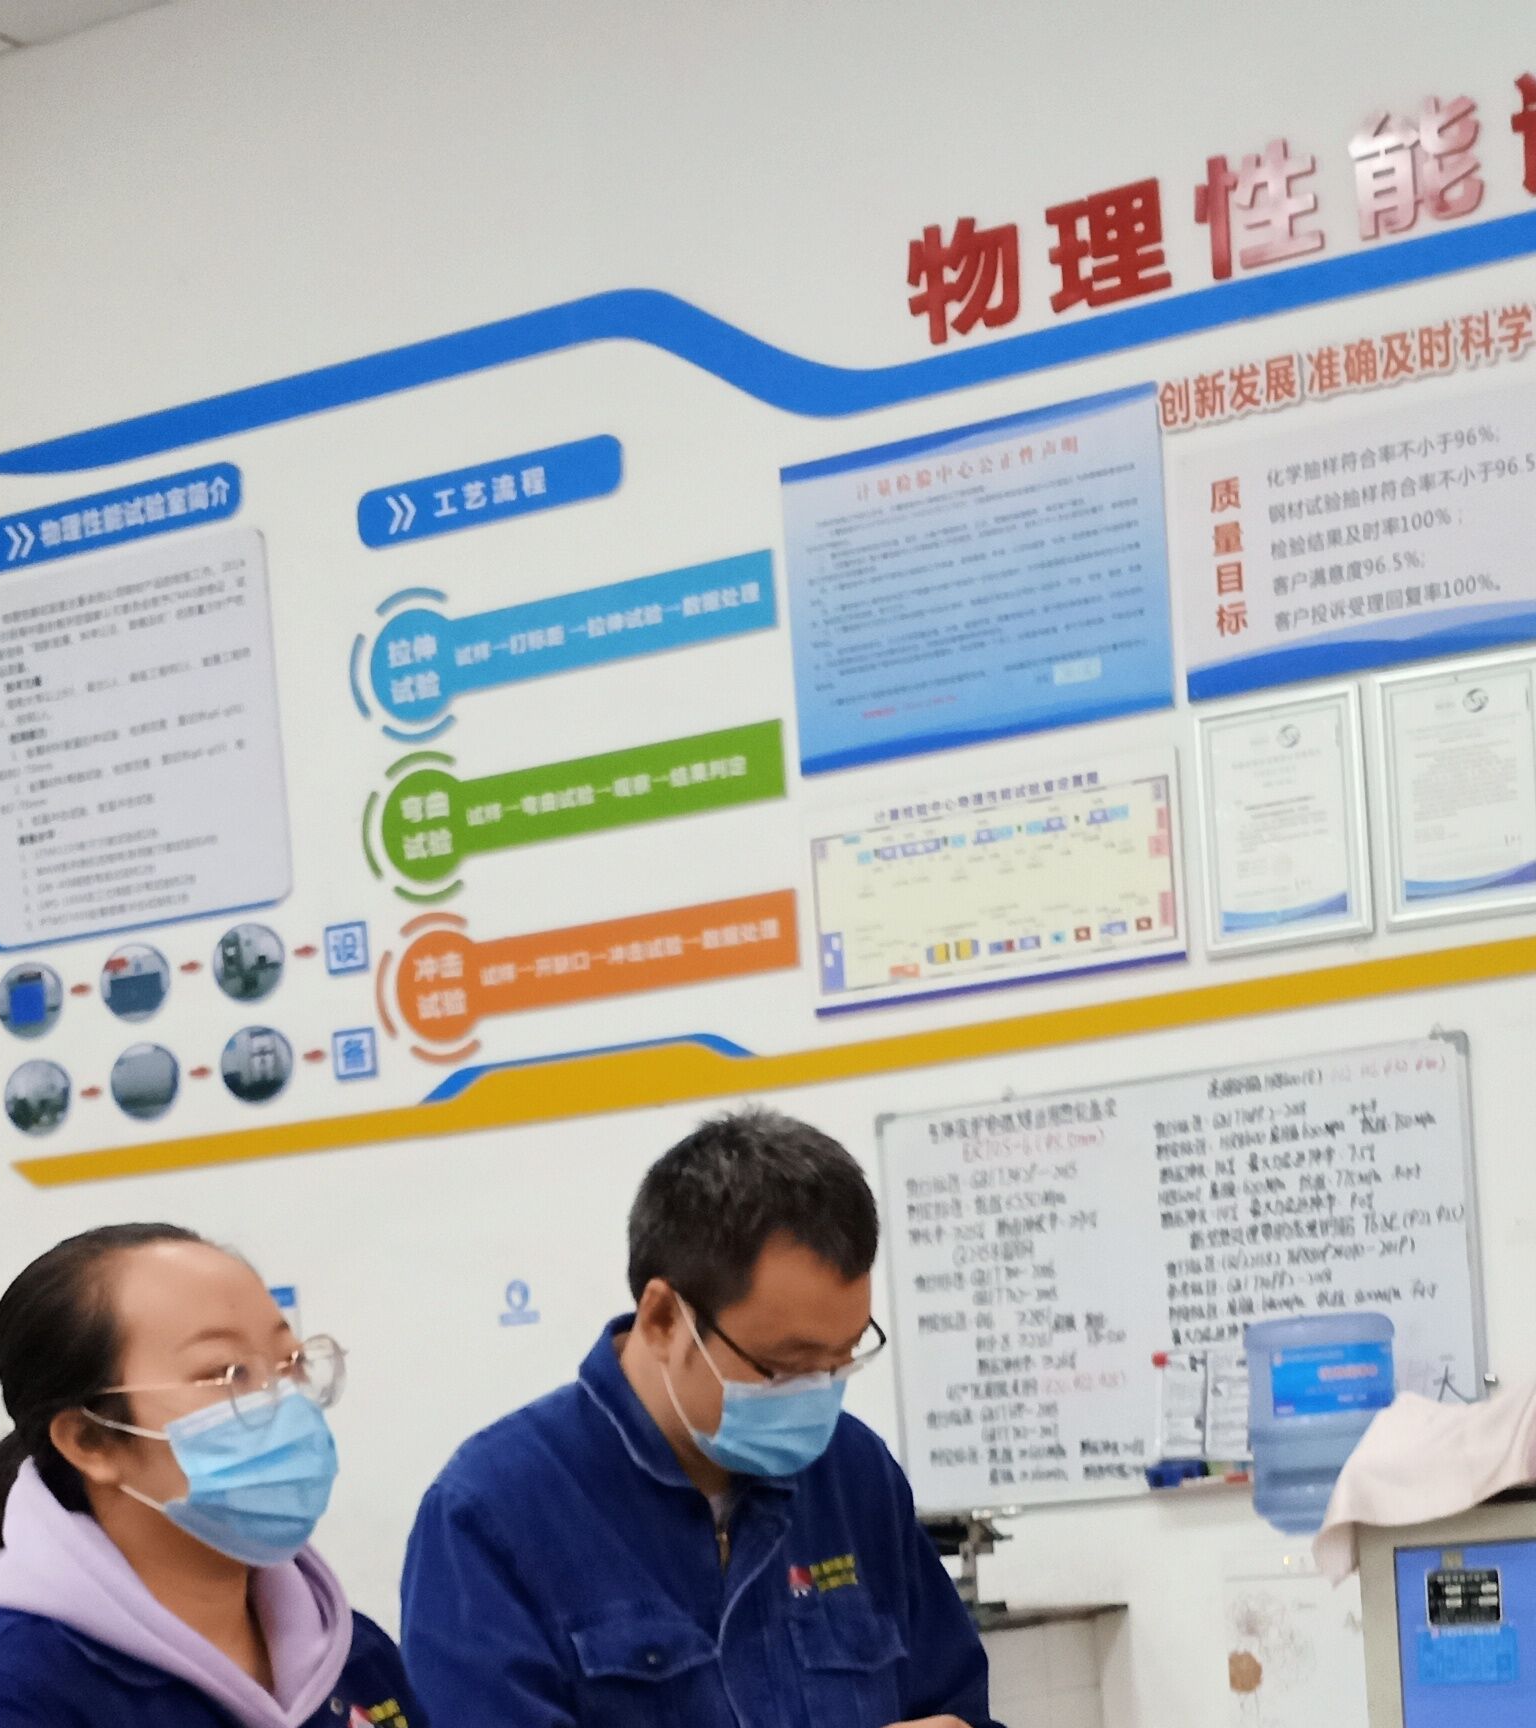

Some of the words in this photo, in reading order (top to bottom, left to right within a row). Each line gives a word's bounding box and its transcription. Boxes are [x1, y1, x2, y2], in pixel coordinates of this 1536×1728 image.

[1159, 353, 1296, 428] 创新发展
[1307, 321, 1452, 394] 准确及时
[434, 466, 547, 517] 工艺流程
[39, 475, 230, 547] 物理性能试验室简介
[1210, 476, 1247, 637] 质量目标
[387, 633, 438, 668] 拉伸
[390, 671, 441, 705] 试验
[400, 791, 450, 822] 弯曲
[402, 828, 453, 861] 试验
[413, 951, 464, 983] 冲击
[416, 988, 467, 1021] 试验
